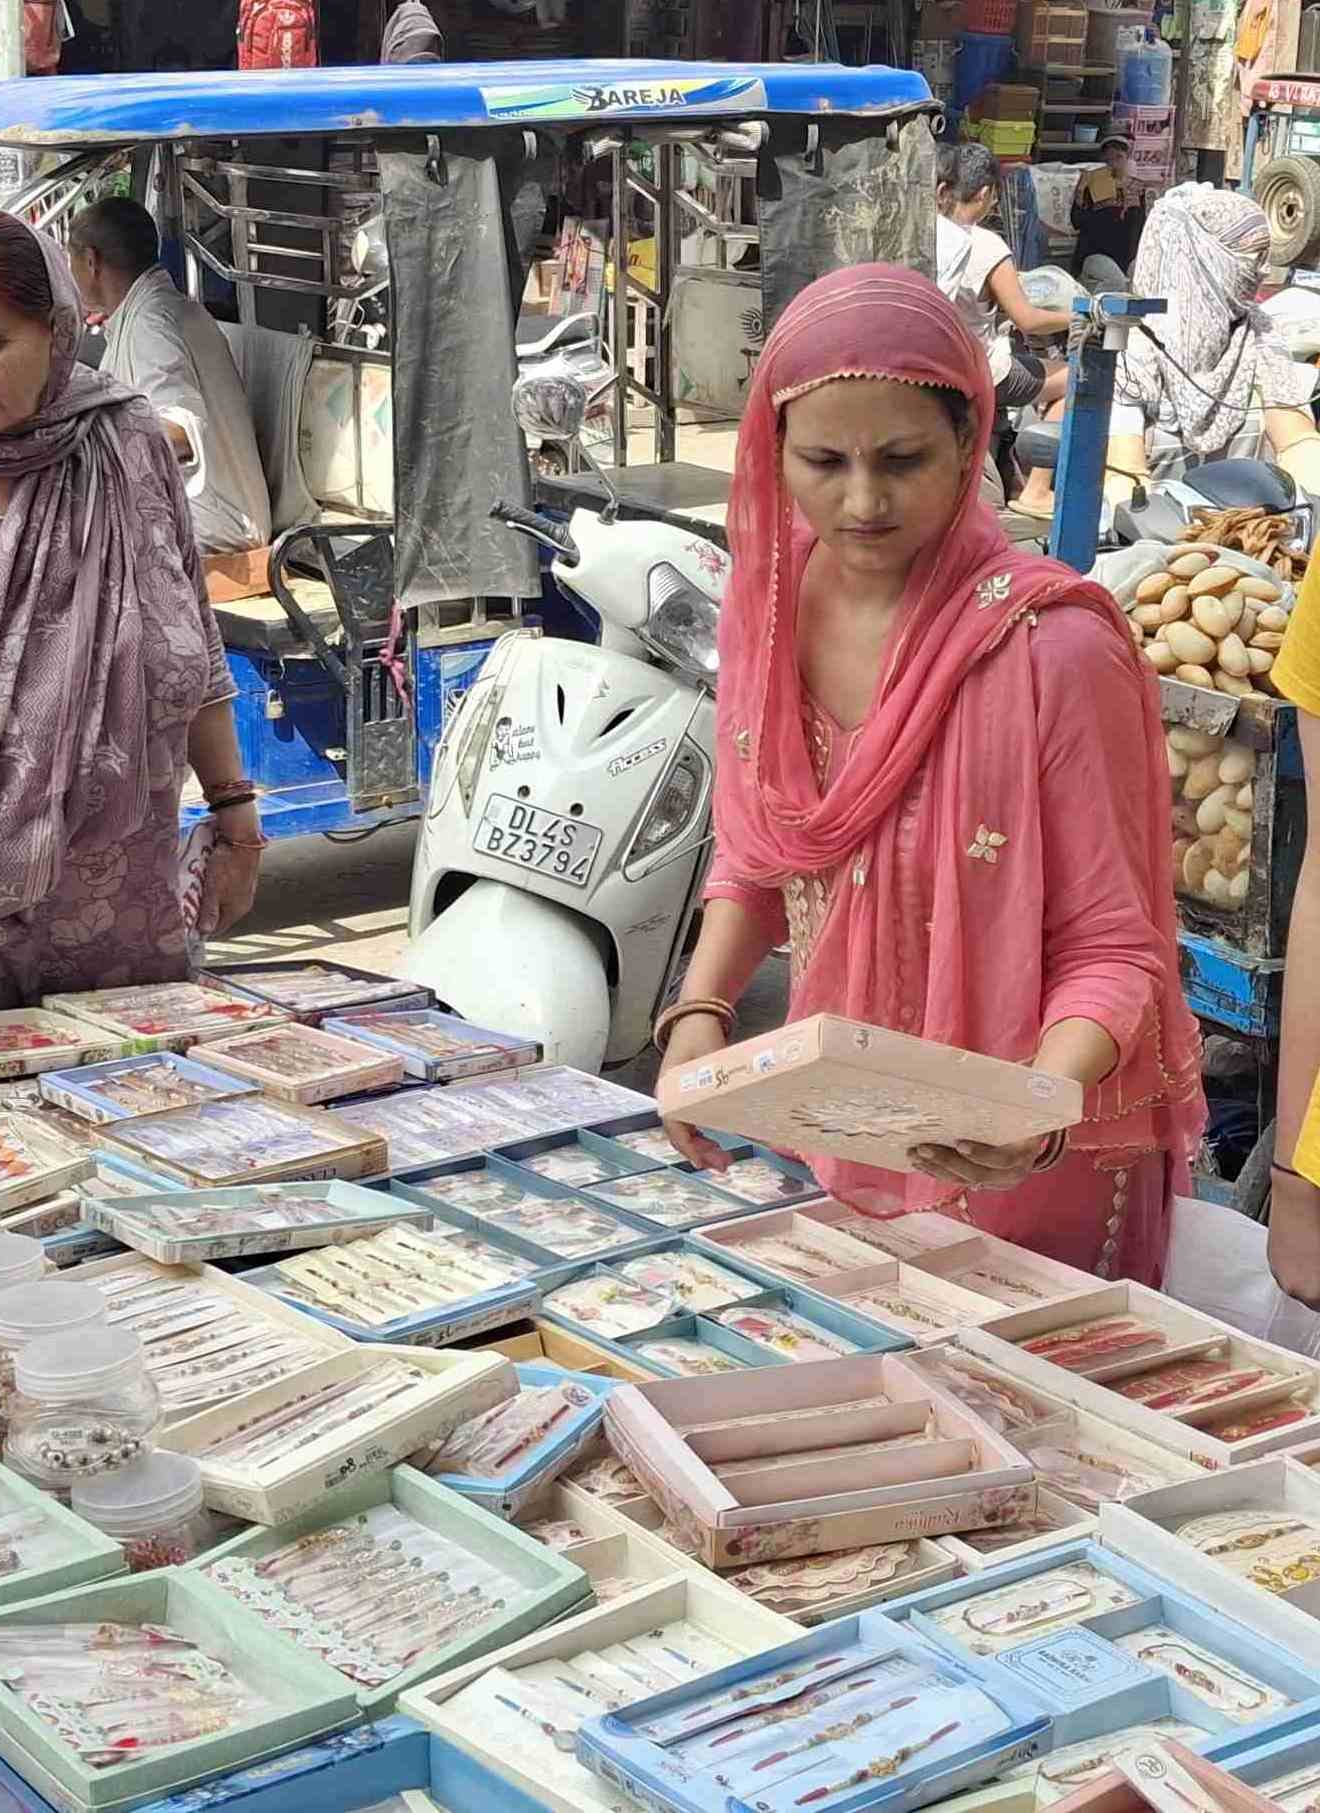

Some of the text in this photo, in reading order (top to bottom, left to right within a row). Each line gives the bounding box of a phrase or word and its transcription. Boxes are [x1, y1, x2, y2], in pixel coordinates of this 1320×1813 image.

[574, 84, 684, 111] BAREJA
[607, 738, 666, 777] Access
[509, 806, 577, 846] DL4S
[487, 827, 589, 881] BZ3794
